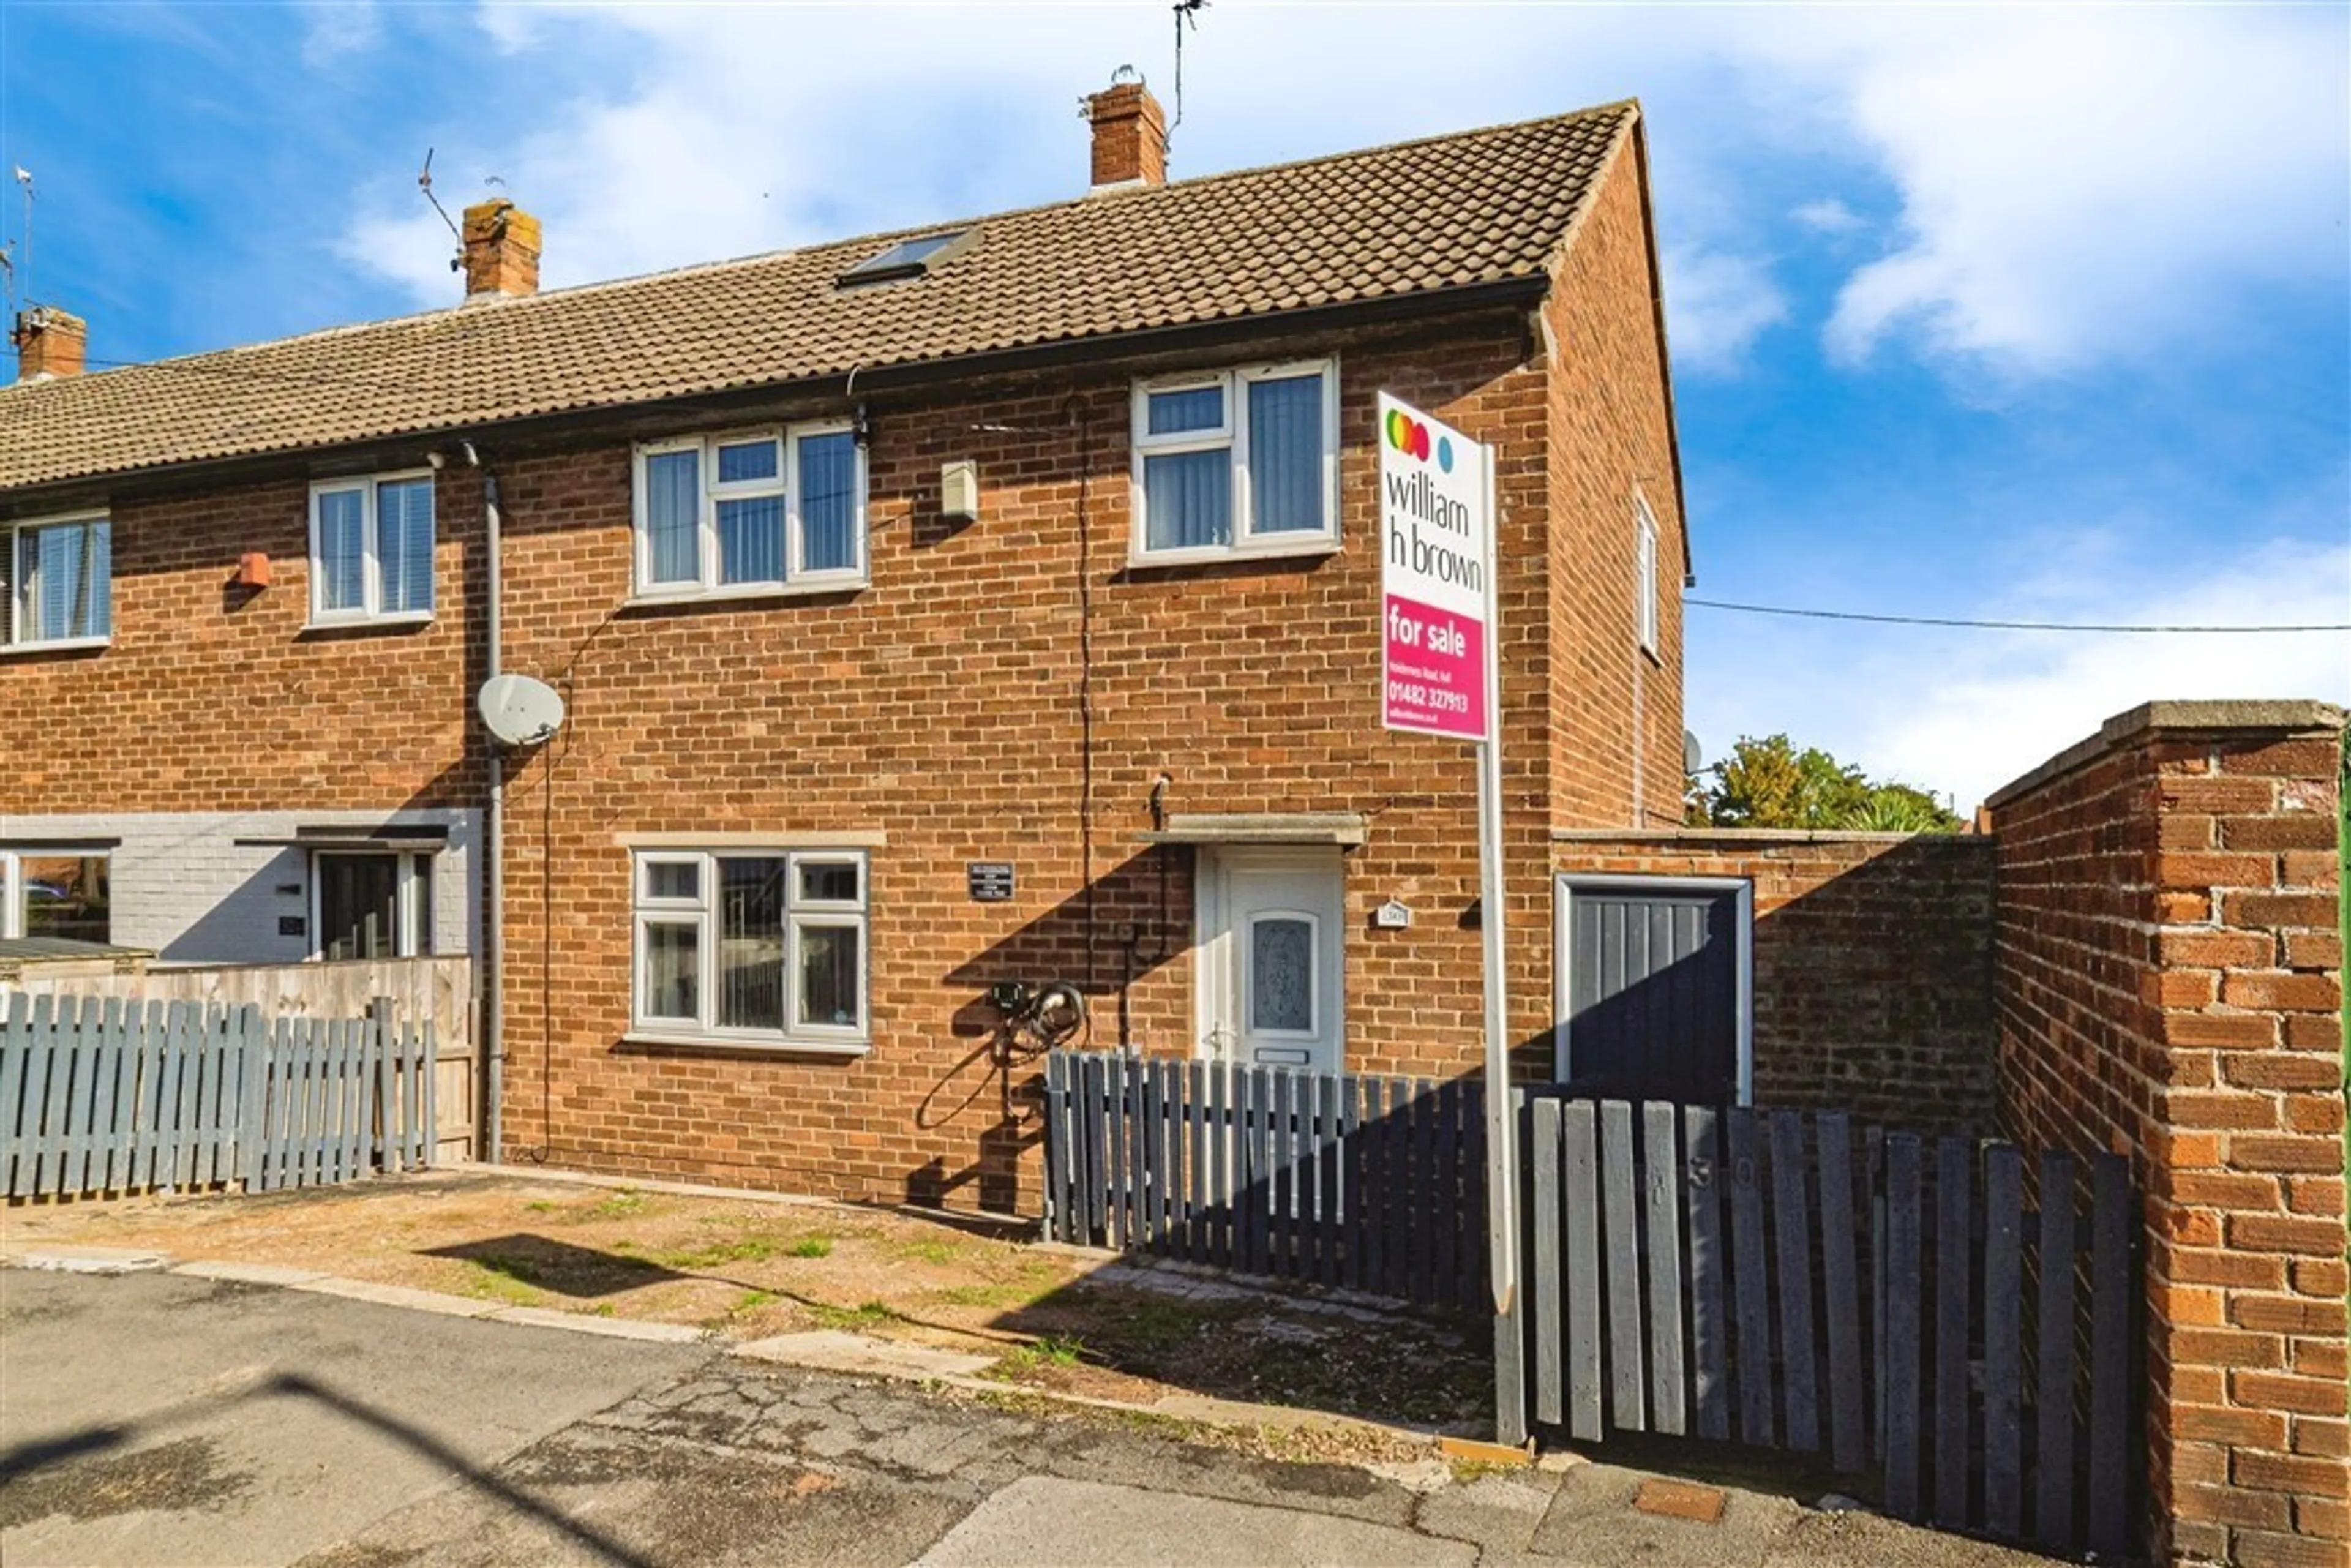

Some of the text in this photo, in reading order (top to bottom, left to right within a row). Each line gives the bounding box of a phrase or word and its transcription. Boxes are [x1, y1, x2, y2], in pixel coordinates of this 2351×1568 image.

[1386, 471, 1468, 537] william
[1390, 514, 1482, 593] h brown
[1389, 604, 1466, 658] for sale
[1389, 680, 1427, 707] 01482
